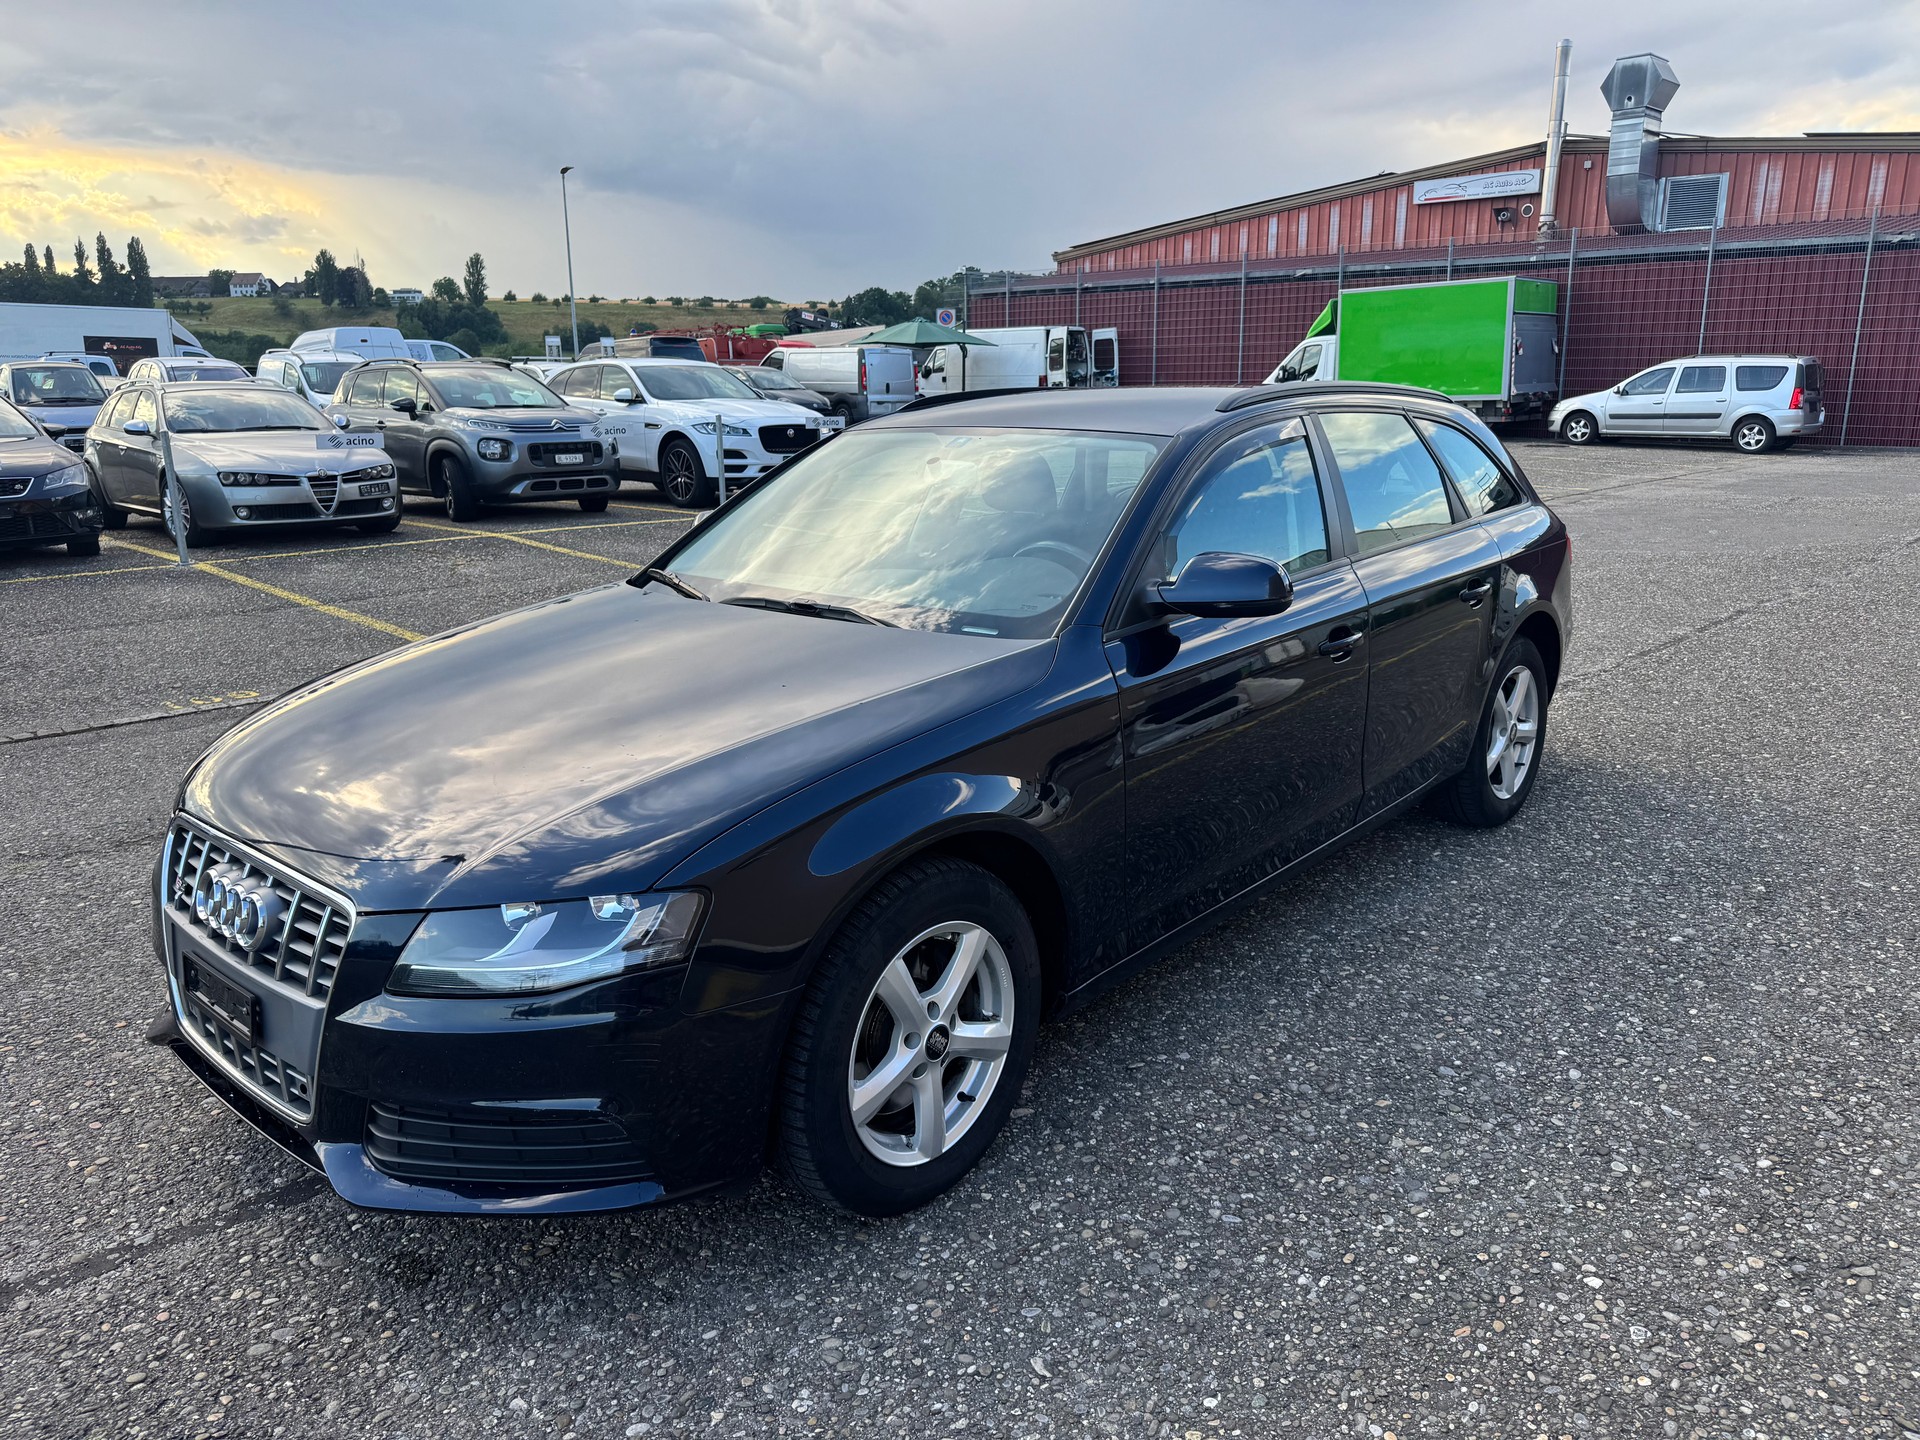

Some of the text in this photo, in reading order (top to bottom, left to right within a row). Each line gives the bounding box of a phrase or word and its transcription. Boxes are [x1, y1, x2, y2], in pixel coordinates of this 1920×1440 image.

[822, 418, 839, 426] acino
[604, 426, 626, 435] acino
[346, 436, 374, 445] acino
